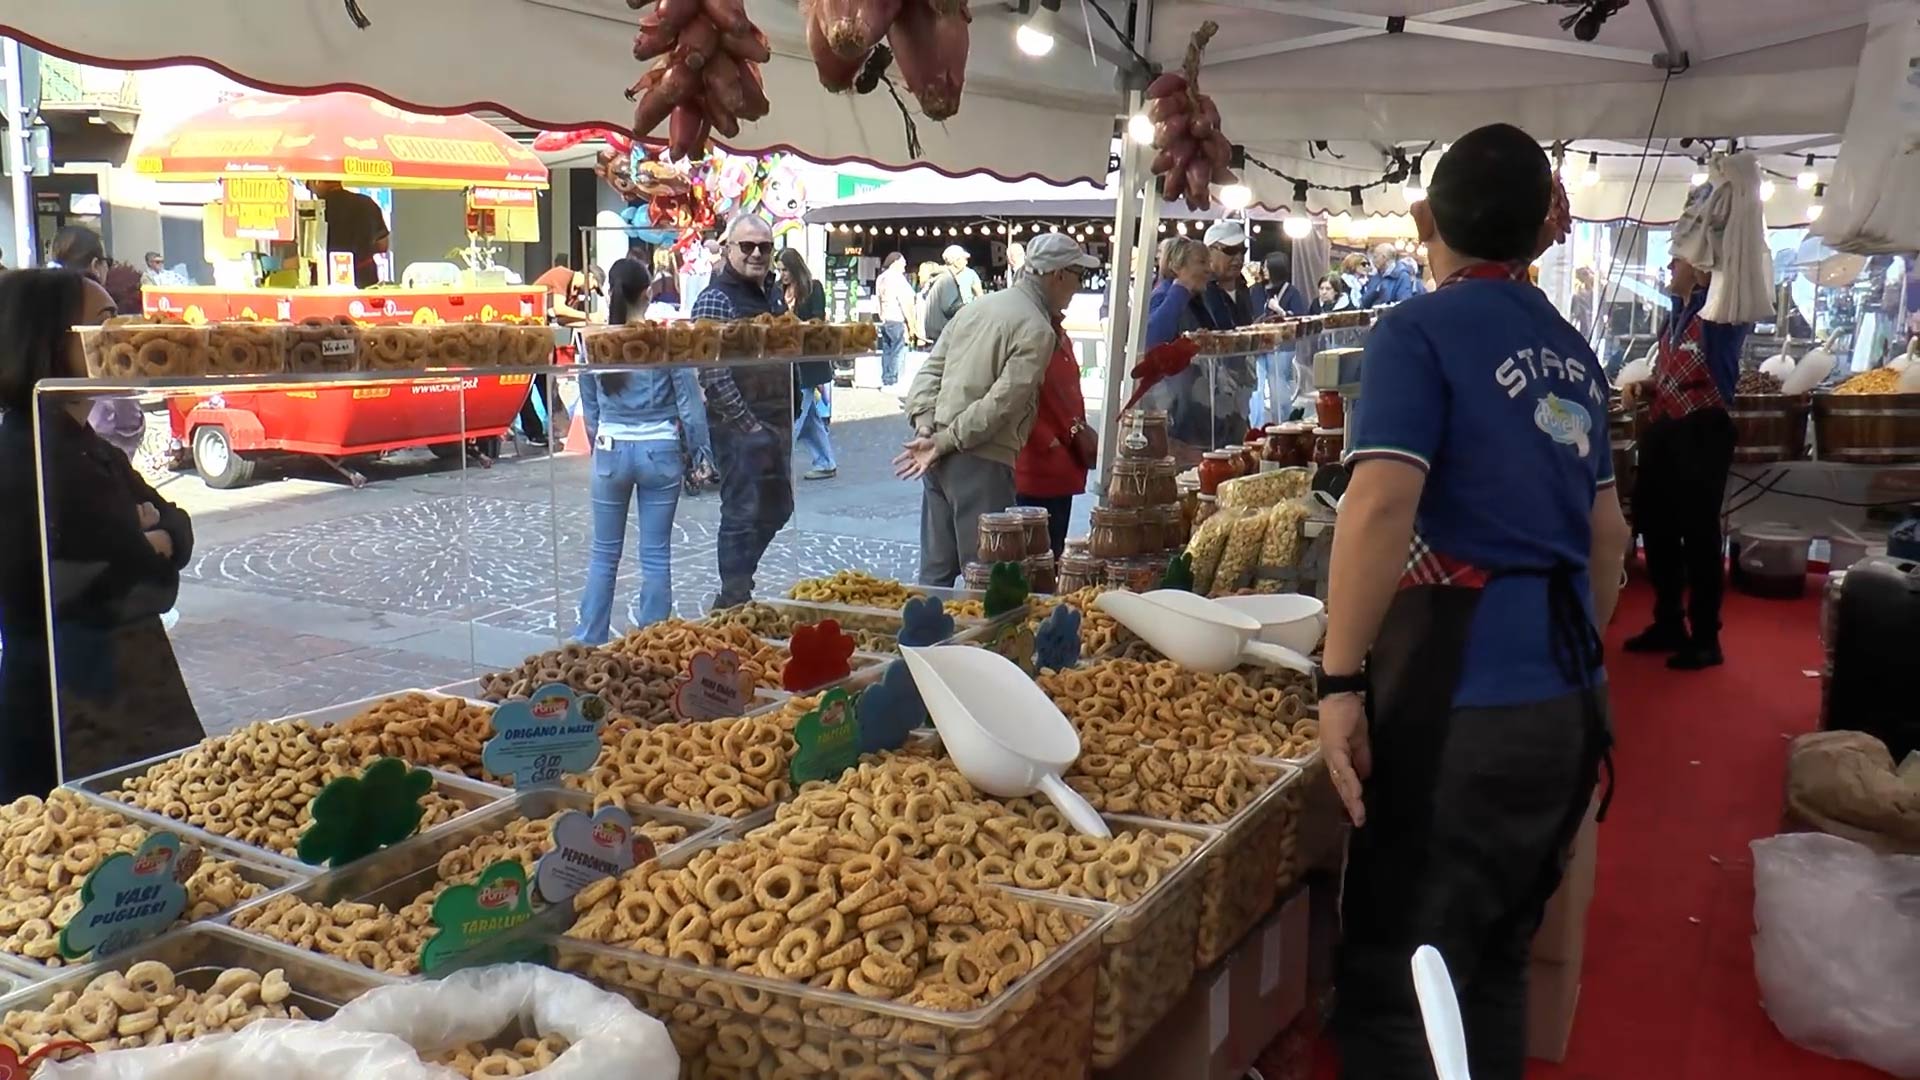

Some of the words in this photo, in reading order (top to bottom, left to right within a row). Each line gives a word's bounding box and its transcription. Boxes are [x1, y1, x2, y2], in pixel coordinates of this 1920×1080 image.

[389, 137, 505, 164] CHURRERIA
[346, 158, 392, 175] Churros
[230, 178, 286, 200] Churros
[504, 725, 558, 740] ORIGANO
[114, 884, 162, 908] VASI
[89, 900, 167, 928] PUGLIESI
